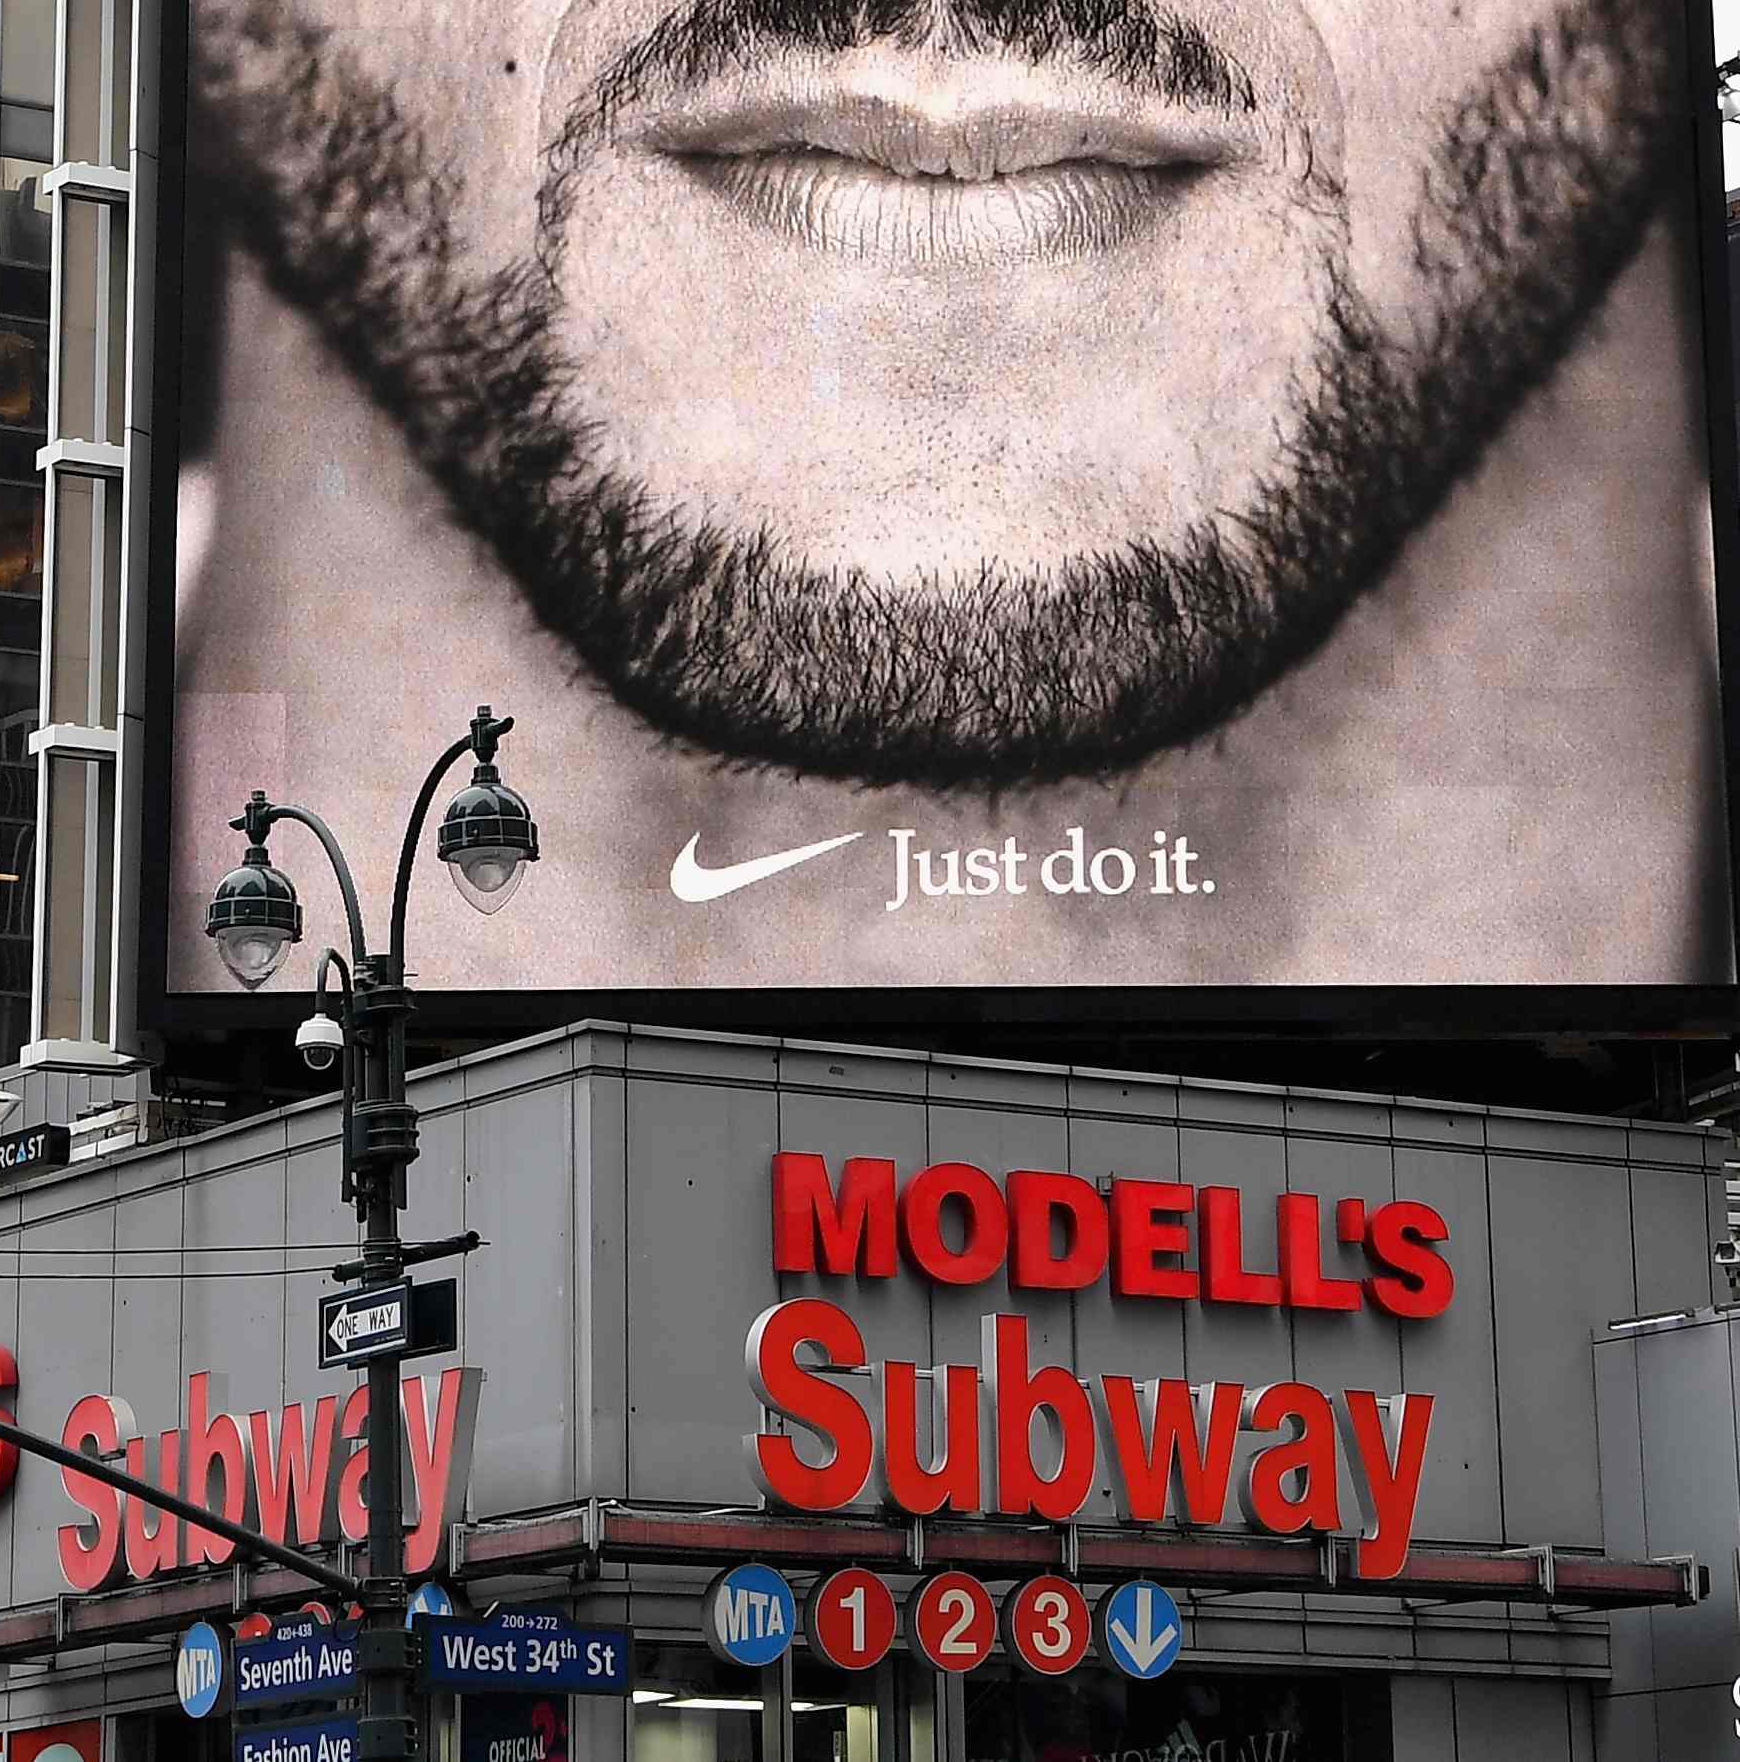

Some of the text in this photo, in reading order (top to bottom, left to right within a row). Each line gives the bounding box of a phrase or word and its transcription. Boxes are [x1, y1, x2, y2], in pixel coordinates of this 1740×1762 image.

[885, 827, 1216, 912] Just do it.
[772, 1151, 1455, 1319] MODELL'S
[336, 1305, 394, 1339] ONE WAY
[743, 1296, 1436, 1580] Subway
[58, 1368, 470, 1592] Subway
[501, 1614, 558, 1630] 200 272
[721, 1588, 1071, 1657] MTA 1 2 3
[177, 1648, 216, 1702] MTA
[240, 1644, 353, 1691] Seventh Ave
[442, 1635, 615, 1677] West 34th St
[317, 1733, 352, 1762] Ave
[489, 1735, 546, 1762] OFFICIAL
